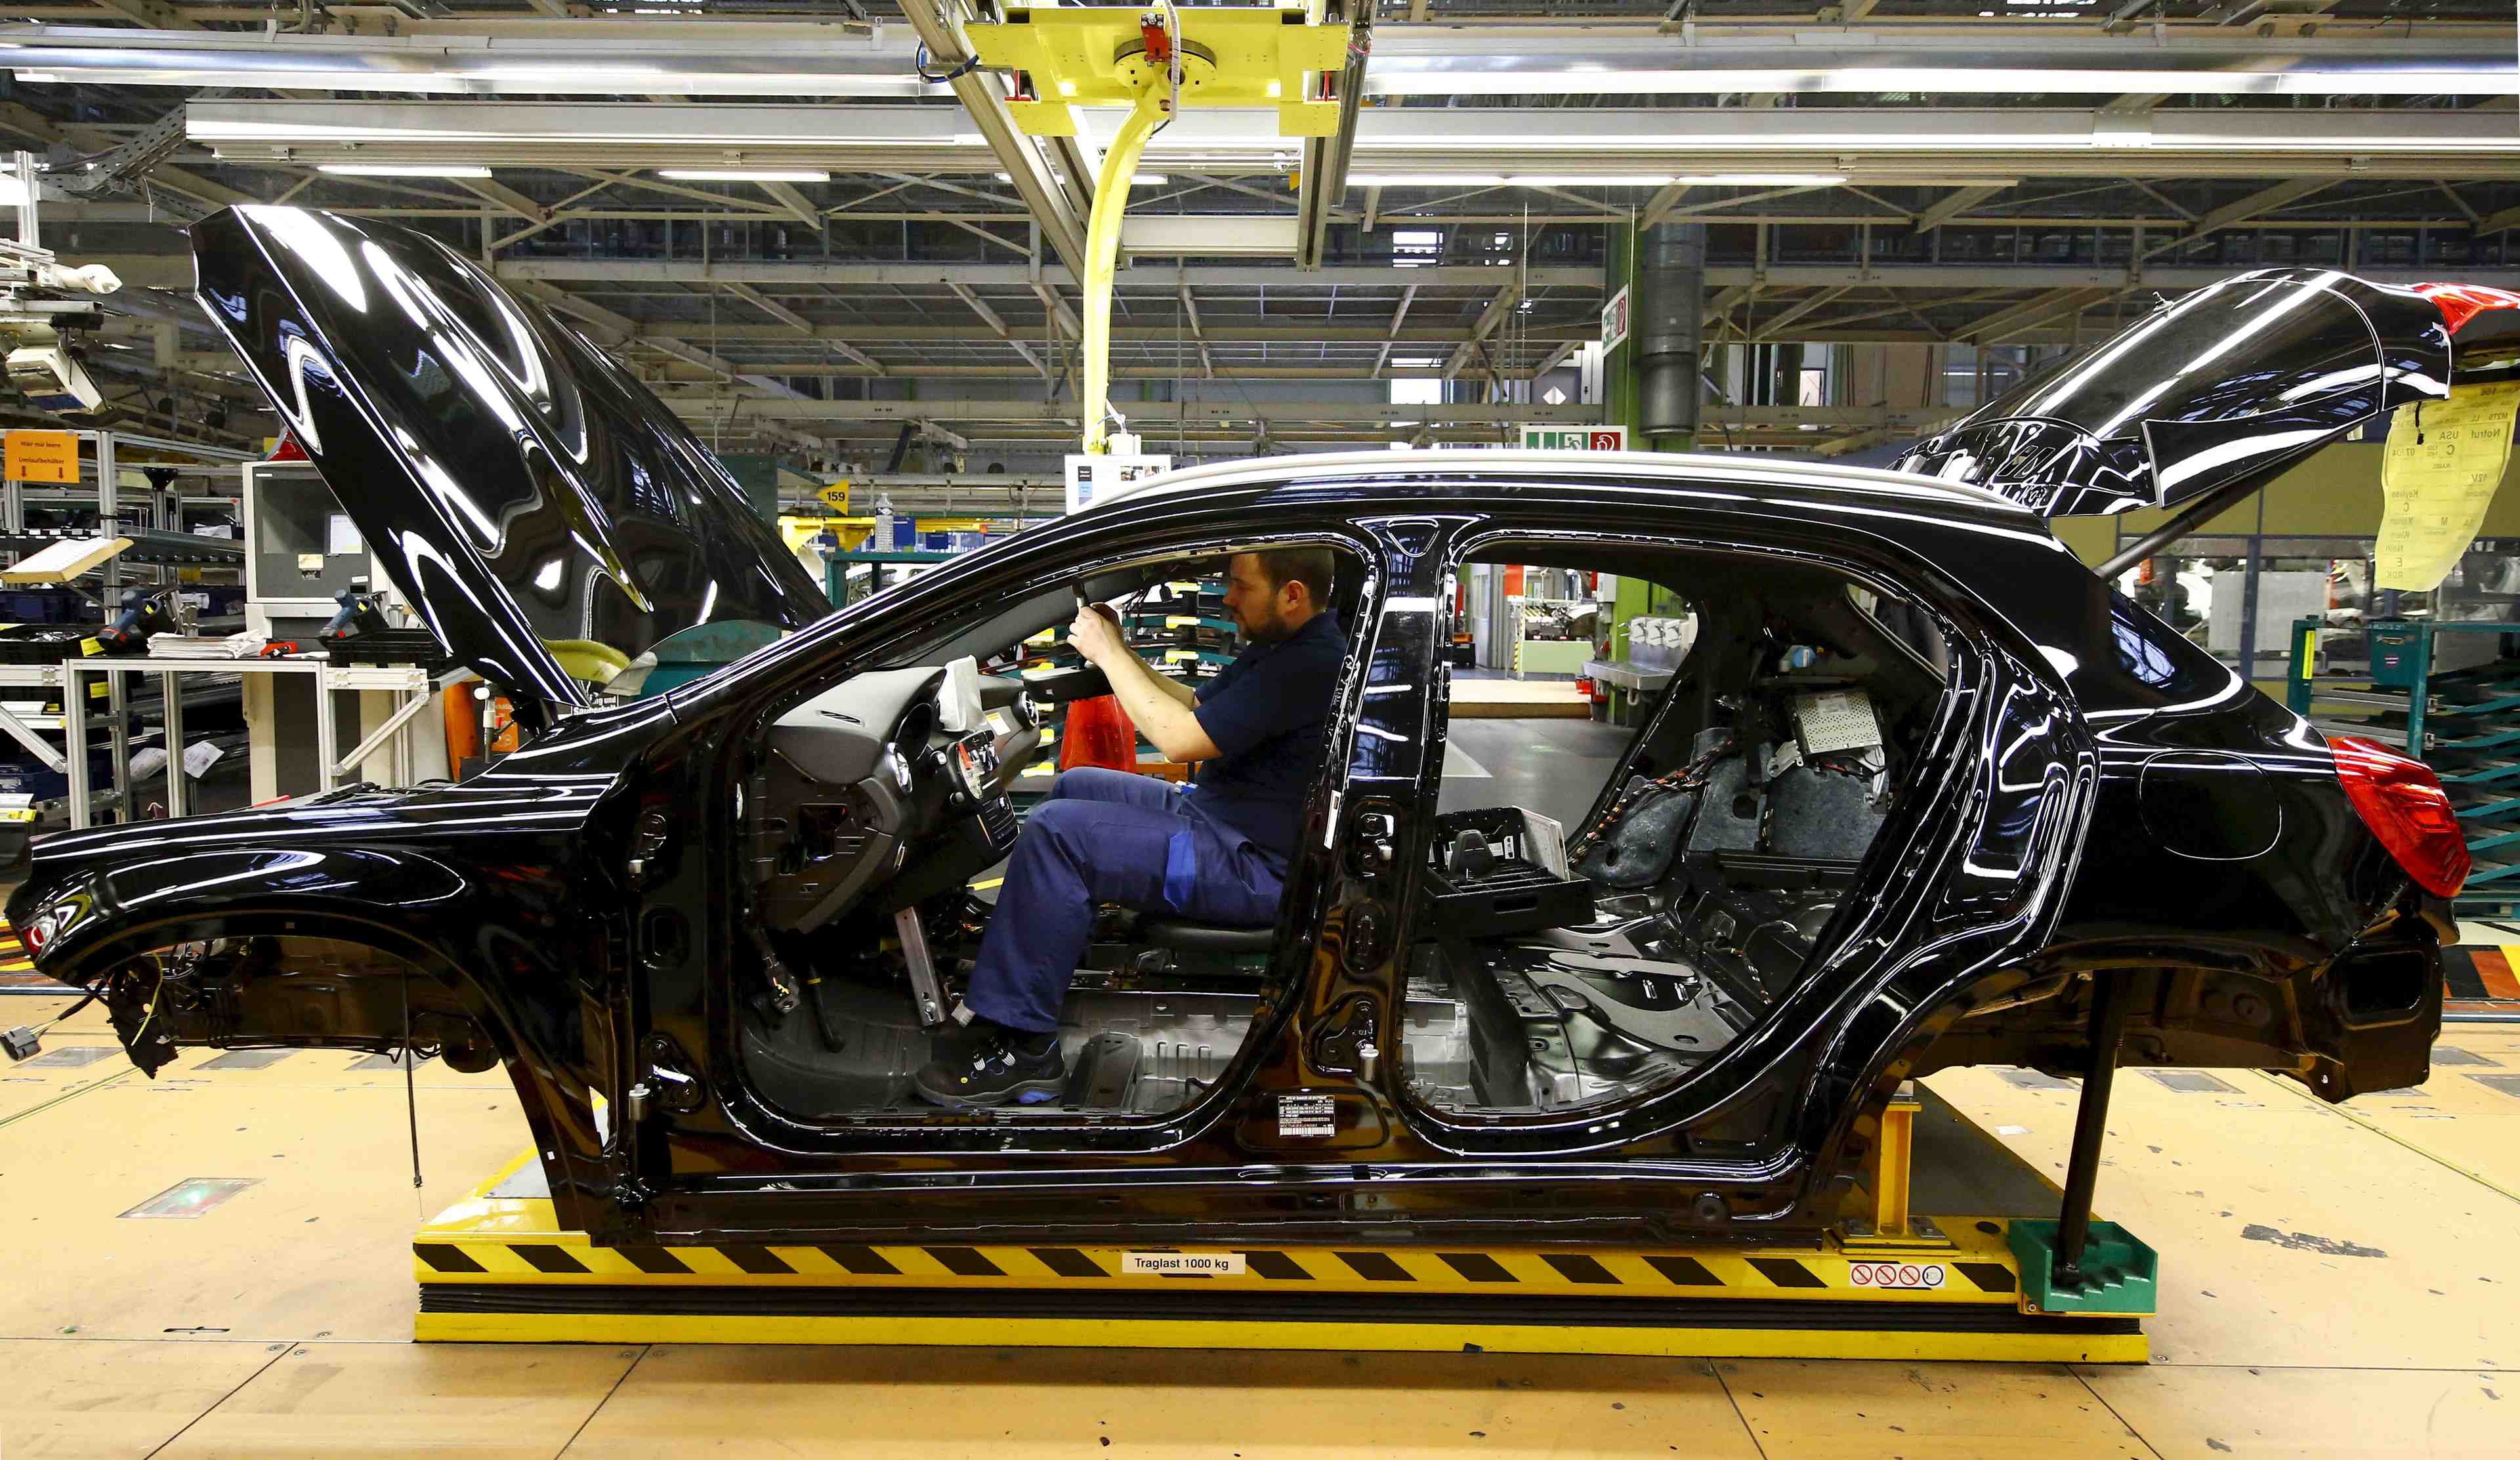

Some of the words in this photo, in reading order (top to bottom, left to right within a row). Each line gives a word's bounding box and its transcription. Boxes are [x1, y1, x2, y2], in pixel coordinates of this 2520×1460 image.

[826, 492, 845, 502] 159
[1135, 1258, 1181, 1270] Traglast
[1185, 1259, 1211, 1268] 1000
[1215, 1259, 1229, 1271] kg
